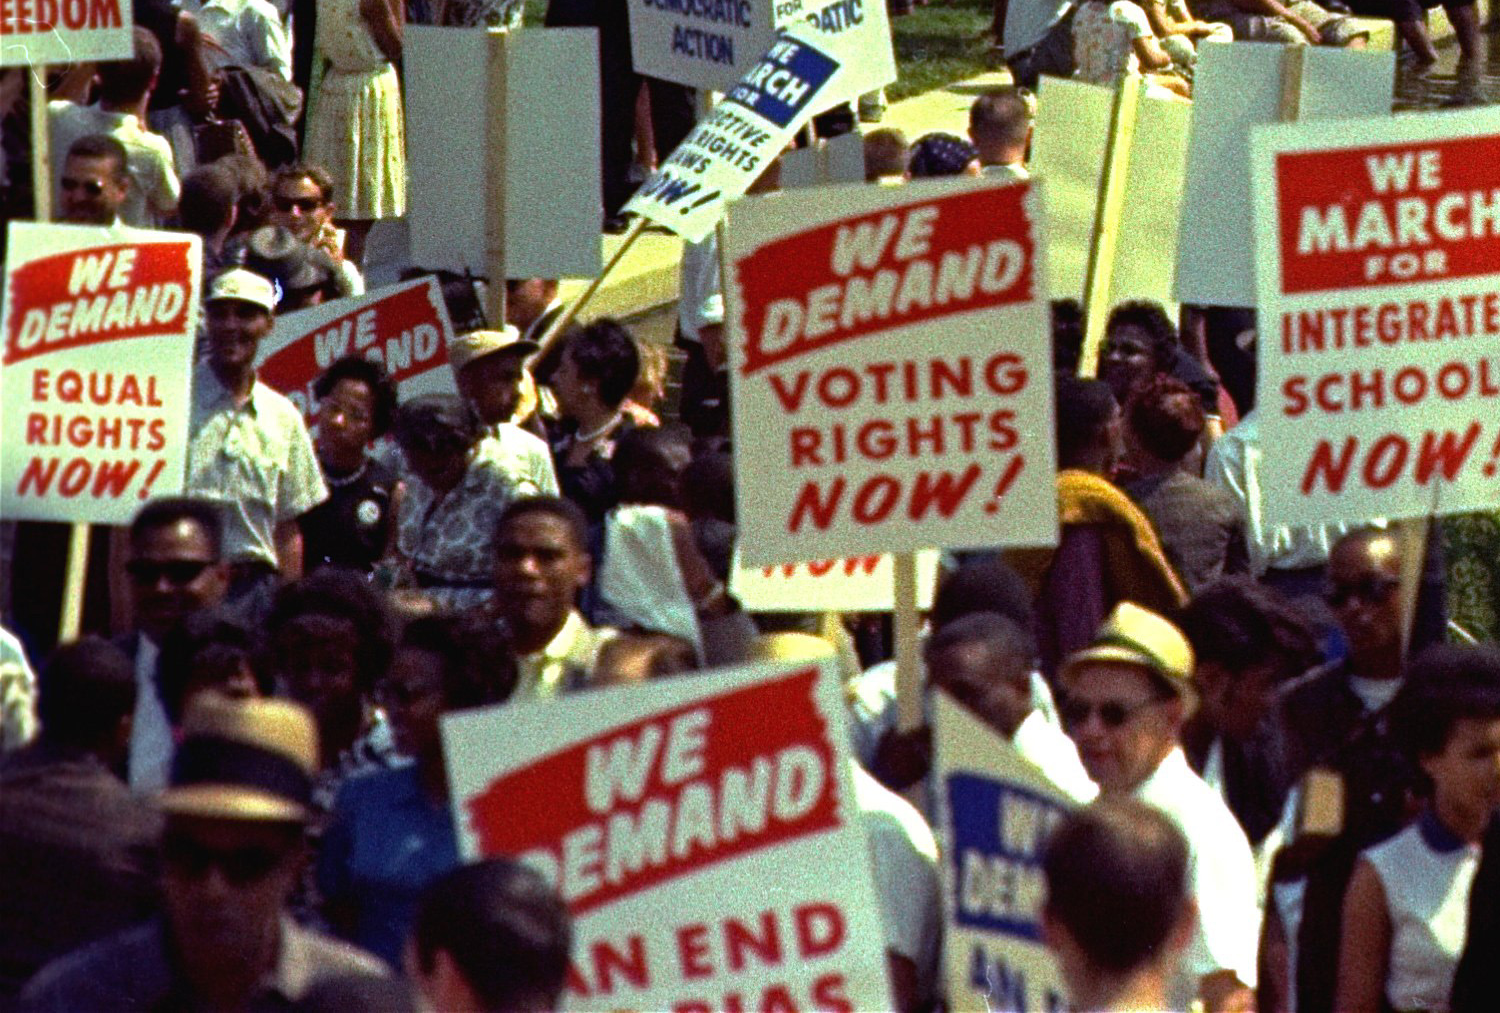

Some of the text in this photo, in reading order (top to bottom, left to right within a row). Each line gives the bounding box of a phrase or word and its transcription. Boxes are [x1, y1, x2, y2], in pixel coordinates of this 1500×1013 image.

[672, 24, 736, 68] ACTION
[696, 128, 763, 173] RIGHTS
[1365, 149, 1442, 193] WE
[831, 205, 941, 277] WE
[1363, 247, 1448, 282] FOR
[67, 247, 139, 297] WE
[761, 239, 1025, 355] DEMAND
[16, 281, 187, 351] DEMAND
[313, 307, 380, 369] WE
[31, 368, 164, 408] EQUAL
[767, 350, 1029, 414] VOTING
[24, 411, 167, 452] RIGHTS
[790, 409, 1019, 469] RIGHTS
[16, 456, 169, 502] NOW!
[787, 452, 1025, 534] NOW!
[585, 707, 713, 817] WE
[677, 900, 849, 983] END
